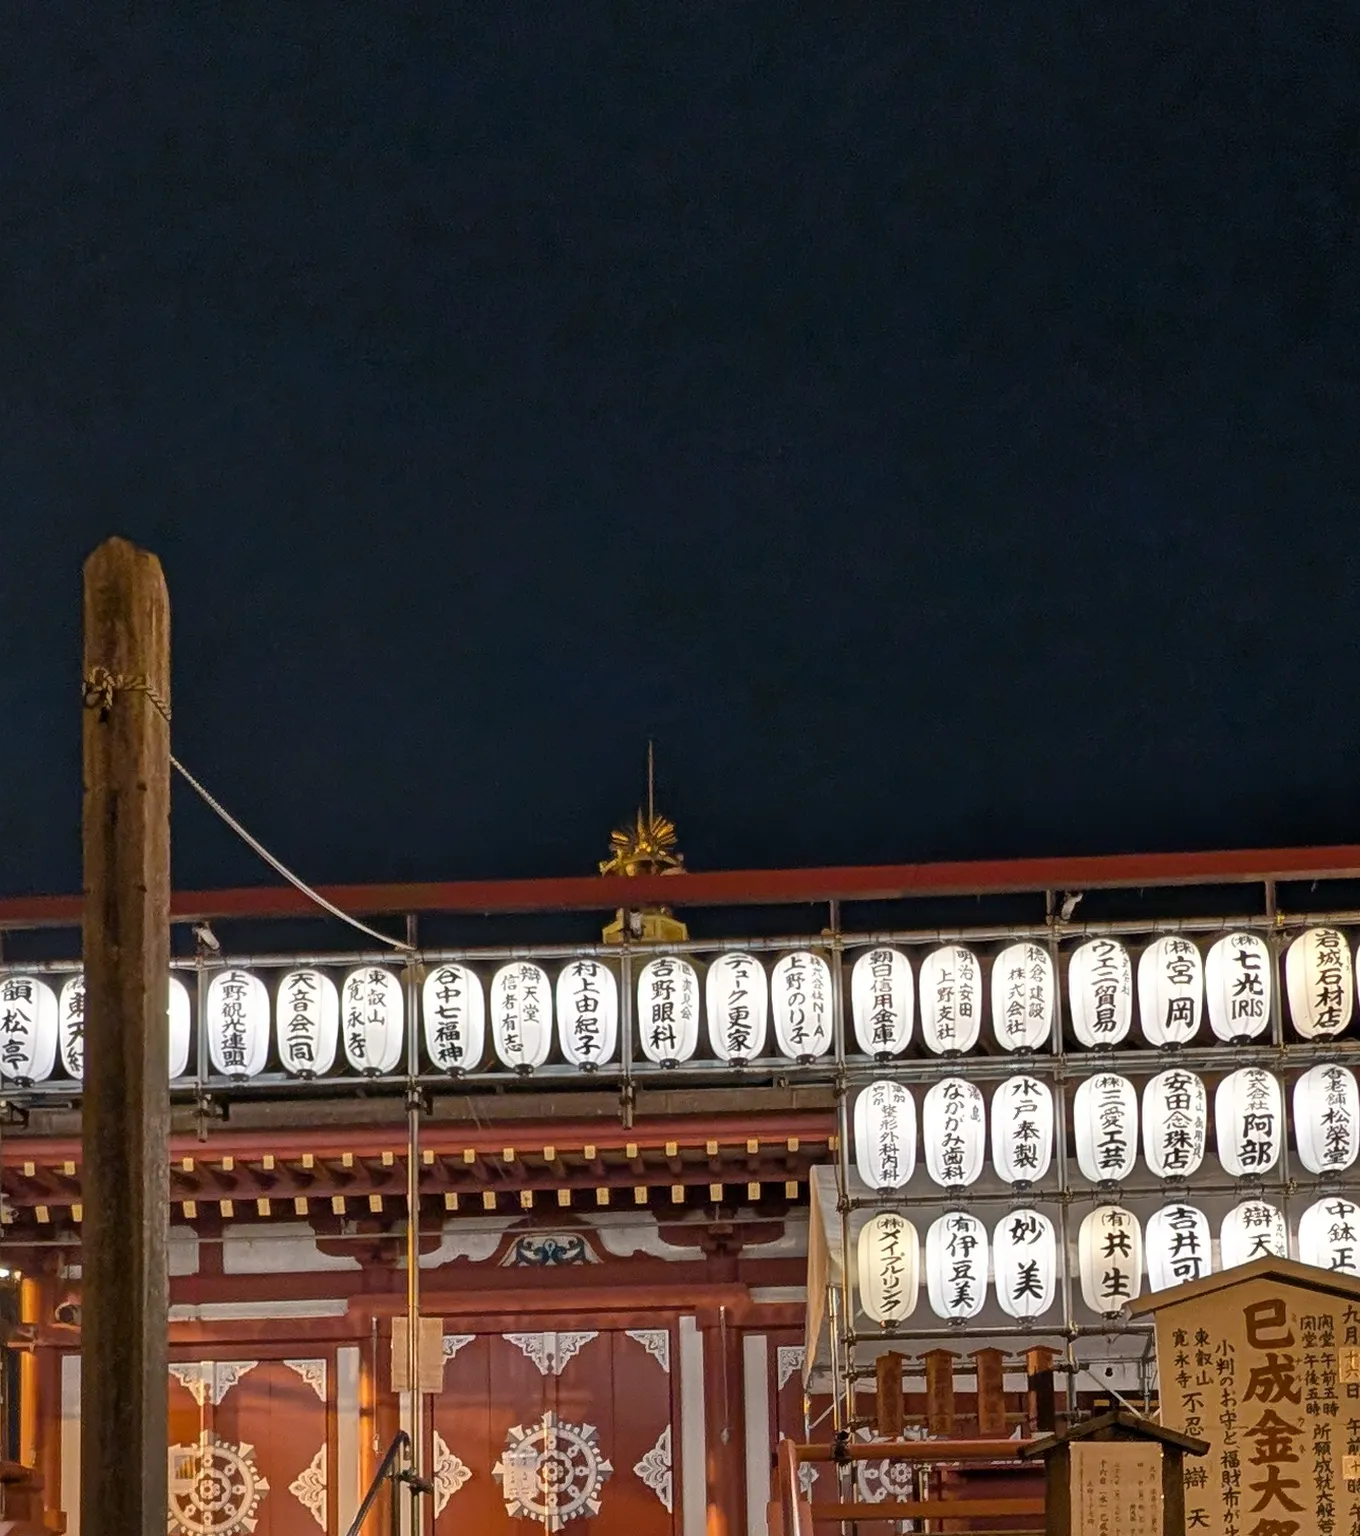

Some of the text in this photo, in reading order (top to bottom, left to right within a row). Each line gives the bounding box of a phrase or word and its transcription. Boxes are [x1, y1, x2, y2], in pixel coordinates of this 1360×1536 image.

[219, 972, 248, 1068] 上野観光連盟
[287, 972, 317, 1062] 天音会一同
[347, 978, 367, 1059] 寛永寺
[367, 969, 389, 1026] 東叡山
[434, 966, 464, 1063] 谷中七福神
[501, 974, 523, 1054] 信者有志
[571, 962, 601, 1055] 村上由紀子
[650, 959, 677, 1049] 吉野眼科
[724, 955, 753, 1052] デューク更家
[783, 957, 809, 1045] 上野のり子
[869, 950, 897, 1045] 朝日信用金庫
[936, 969, 956, 1040] 上野支社
[957, 950, 975, 1018] 明治安田
[1006, 968, 1027, 1035] 株式会社
[1027, 948, 1047, 1020] 徳倉建設
[1312, 930, 1344, 1029] 岩城石材店
[942, 1083, 966, 1181] なかがみ歯科
[1162, 1072, 1194, 1169] 安田念珠店
[1237, 1070, 1274, 1167] 株式会社阿部
[1008, 1216, 1046, 1301] 妙美
[1164, 1207, 1202, 1281] 吉井可
